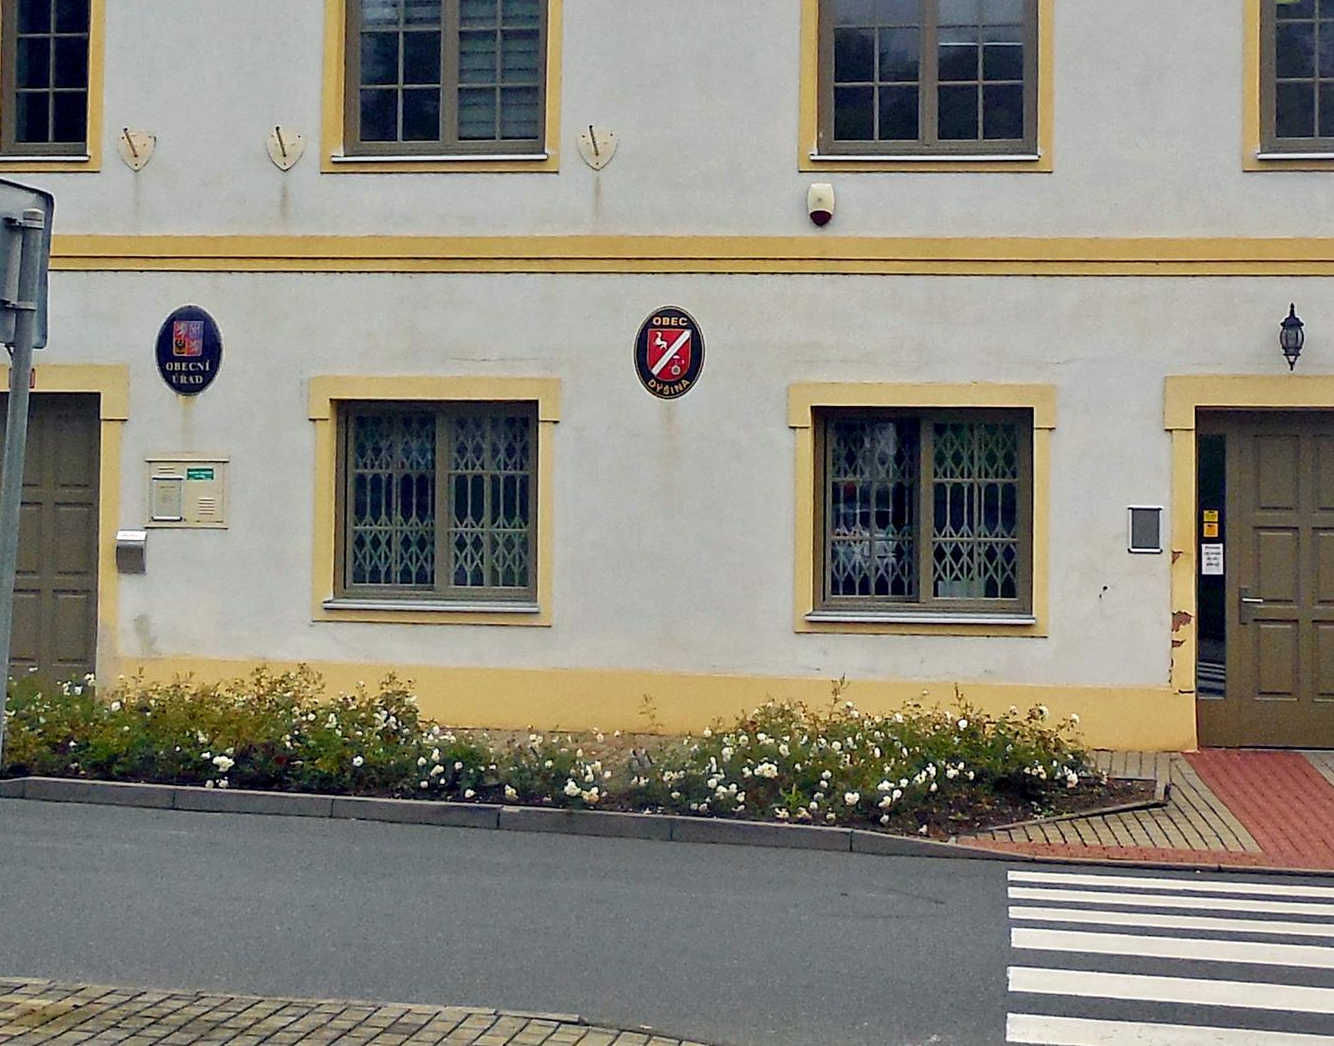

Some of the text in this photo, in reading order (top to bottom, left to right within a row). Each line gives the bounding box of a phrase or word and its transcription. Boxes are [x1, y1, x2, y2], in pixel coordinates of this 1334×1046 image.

[652, 316, 688, 326] OBEC
[165, 359, 210, 371] OBECNÍ
[172, 372, 204, 384] ÚŘAD
